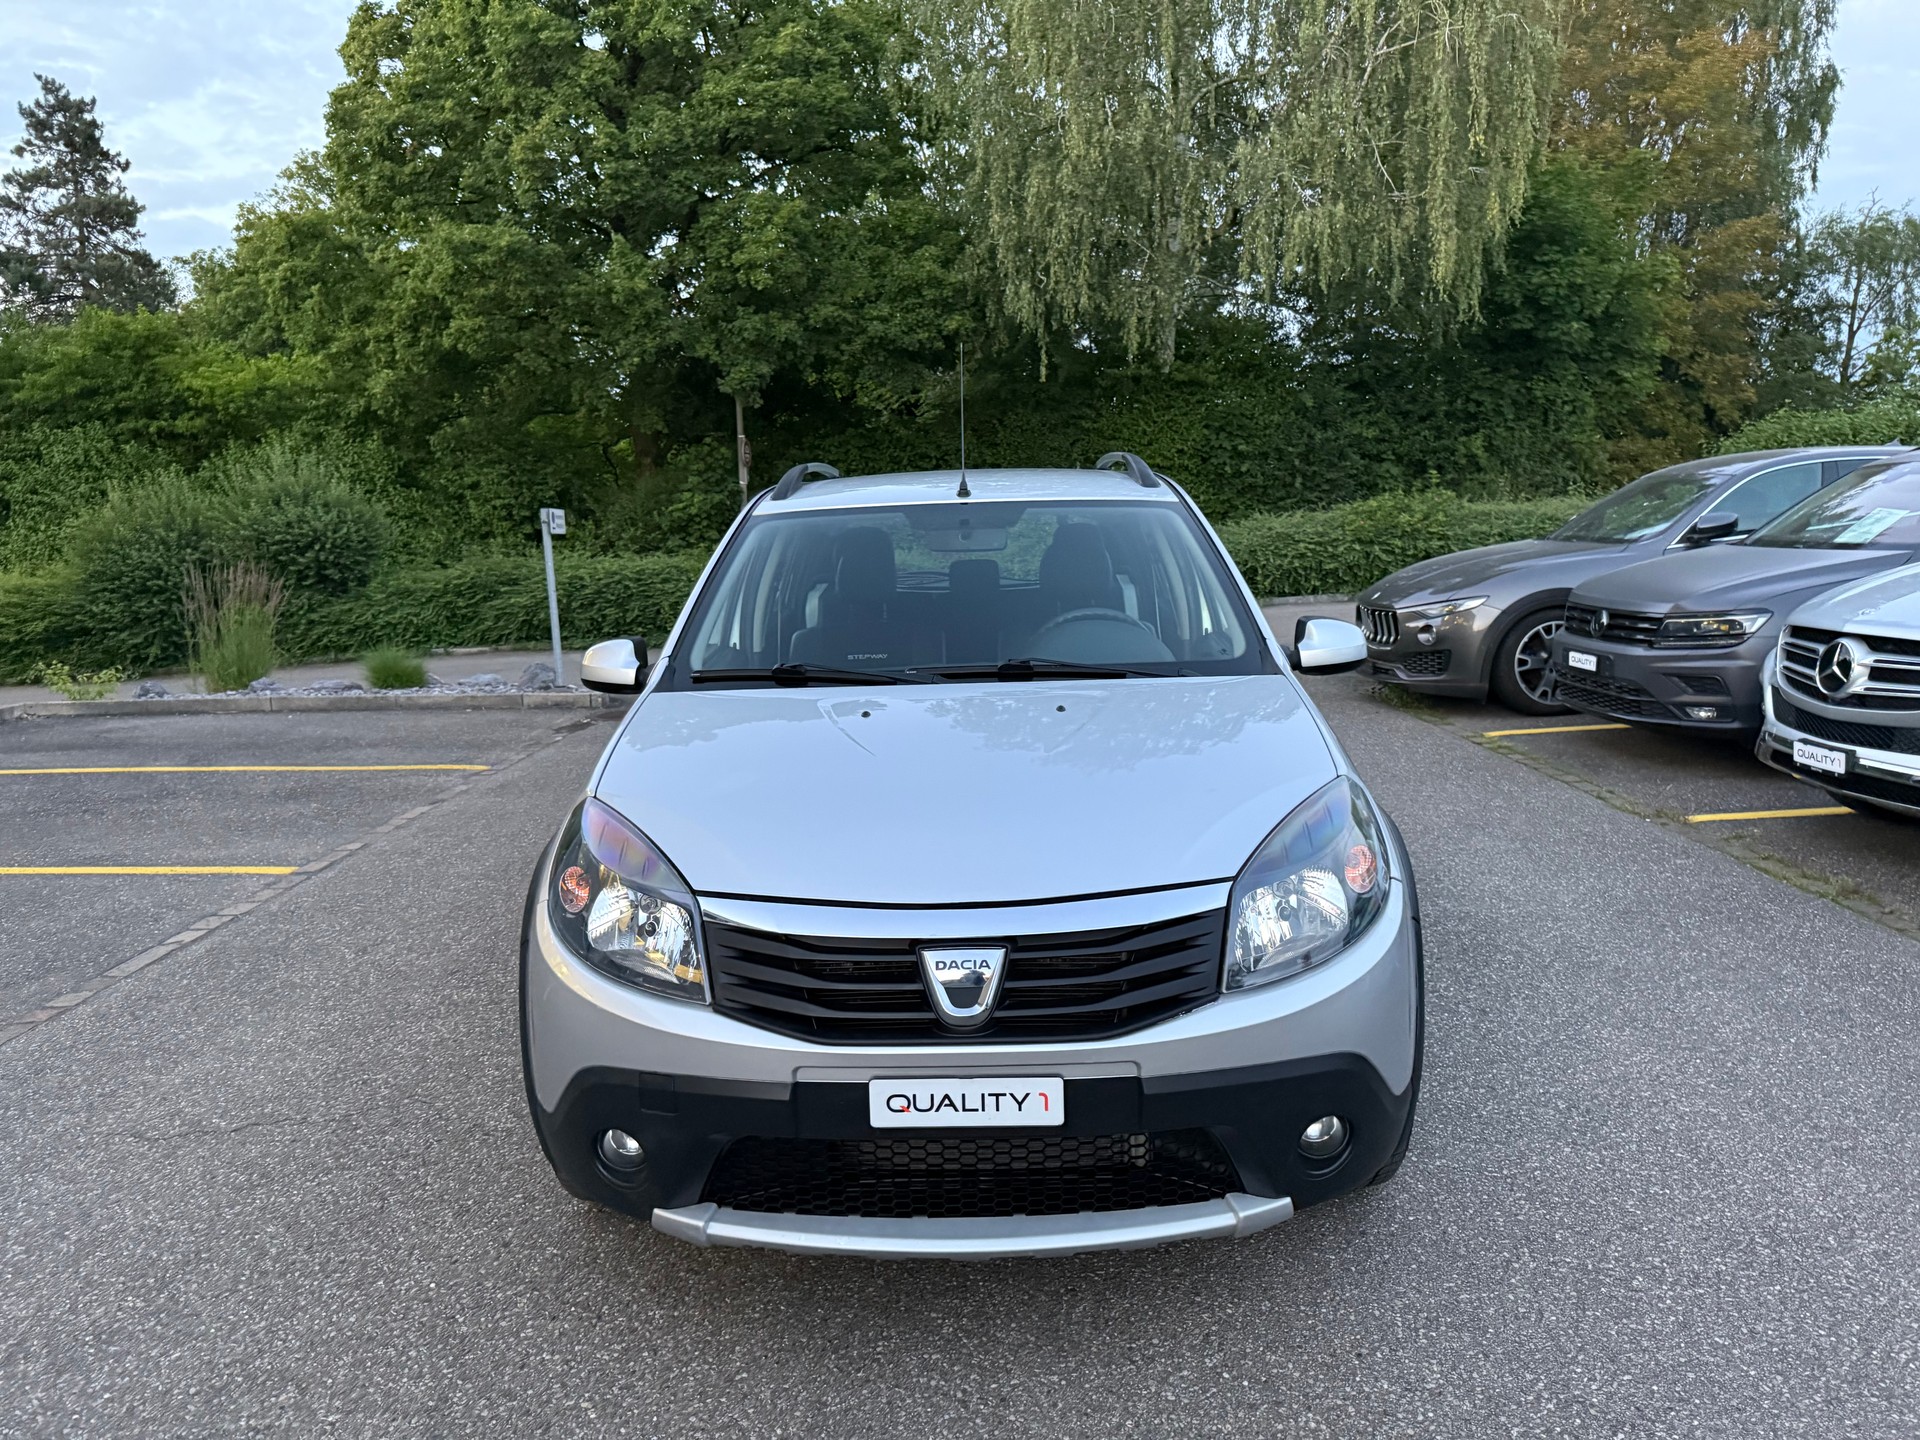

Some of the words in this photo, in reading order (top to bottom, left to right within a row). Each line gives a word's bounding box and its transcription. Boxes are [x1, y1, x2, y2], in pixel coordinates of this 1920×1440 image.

[1797, 748, 1835, 767] QUALITY
[1837, 758, 1842, 769] 1
[935, 959, 991, 971] DACIA
[886, 1092, 1031, 1112] QUALITY
[1038, 1092, 1049, 1111] 1
